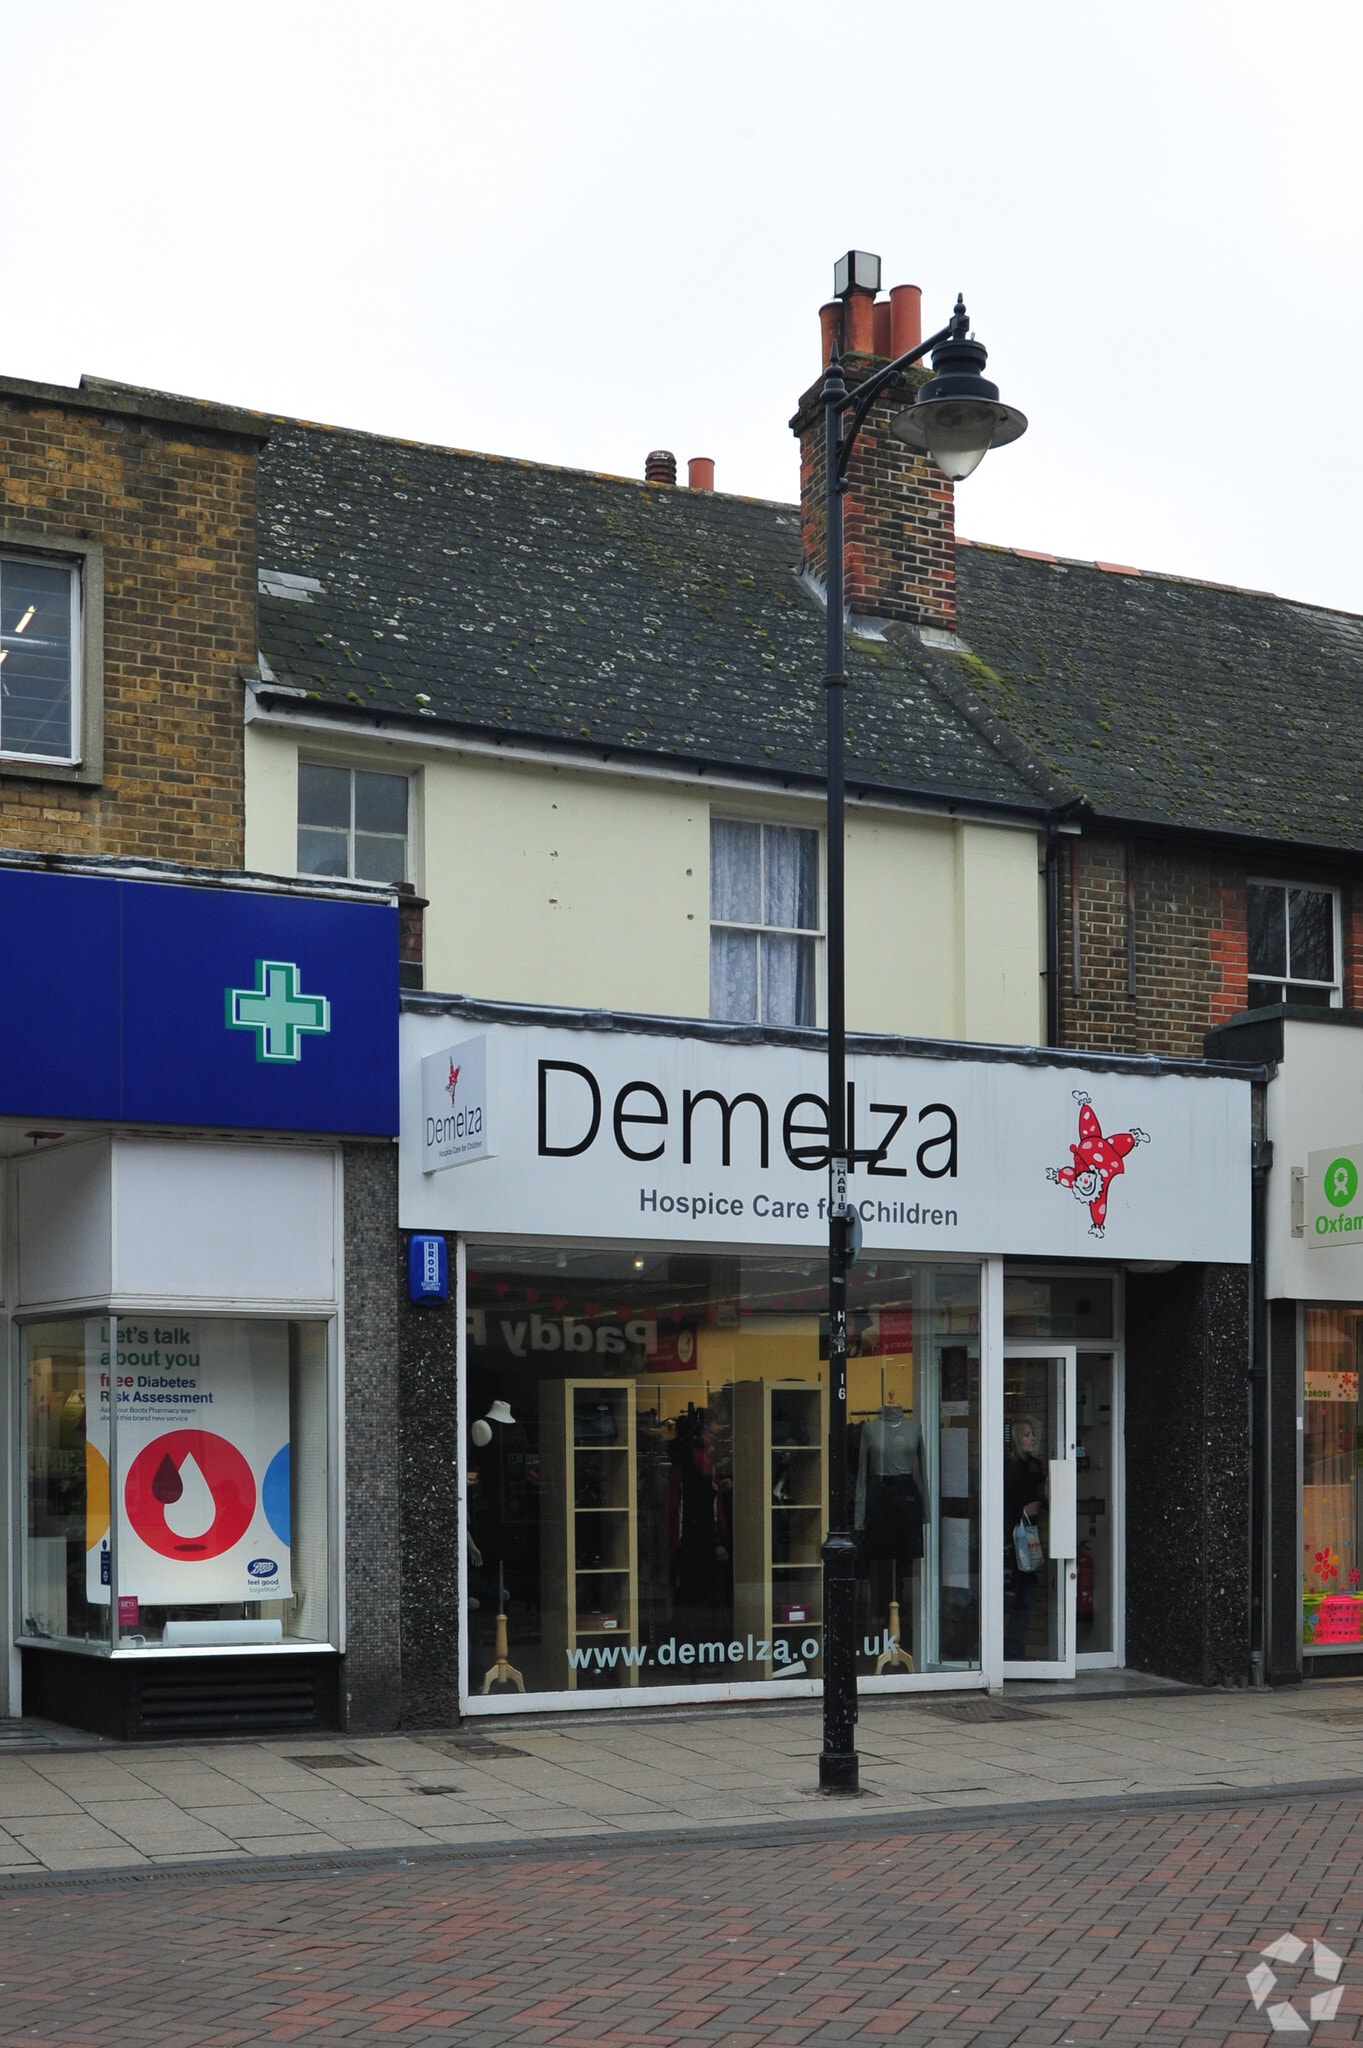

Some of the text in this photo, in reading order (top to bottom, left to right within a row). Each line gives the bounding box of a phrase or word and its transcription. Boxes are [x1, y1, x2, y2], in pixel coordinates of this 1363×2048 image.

[426, 1106, 482, 1146] Demelza
[538, 1059, 957, 1178] Demelza
[640, 1188, 744, 1219] Hospice
[753, 1194, 809, 1219] Care
[859, 1200, 958, 1226] Children
[427, 1242, 435, 1281] BROOK
[101, 1326, 191, 1345] Let's talk
[100, 1348, 200, 1370] about you
[100, 1390, 214, 1403] Rsk Assessment
[138, 1376, 196, 1388] Diabetes
[261, 1579, 279, 1587] good
[566, 1629, 899, 1669] www.demelza.o.uk
